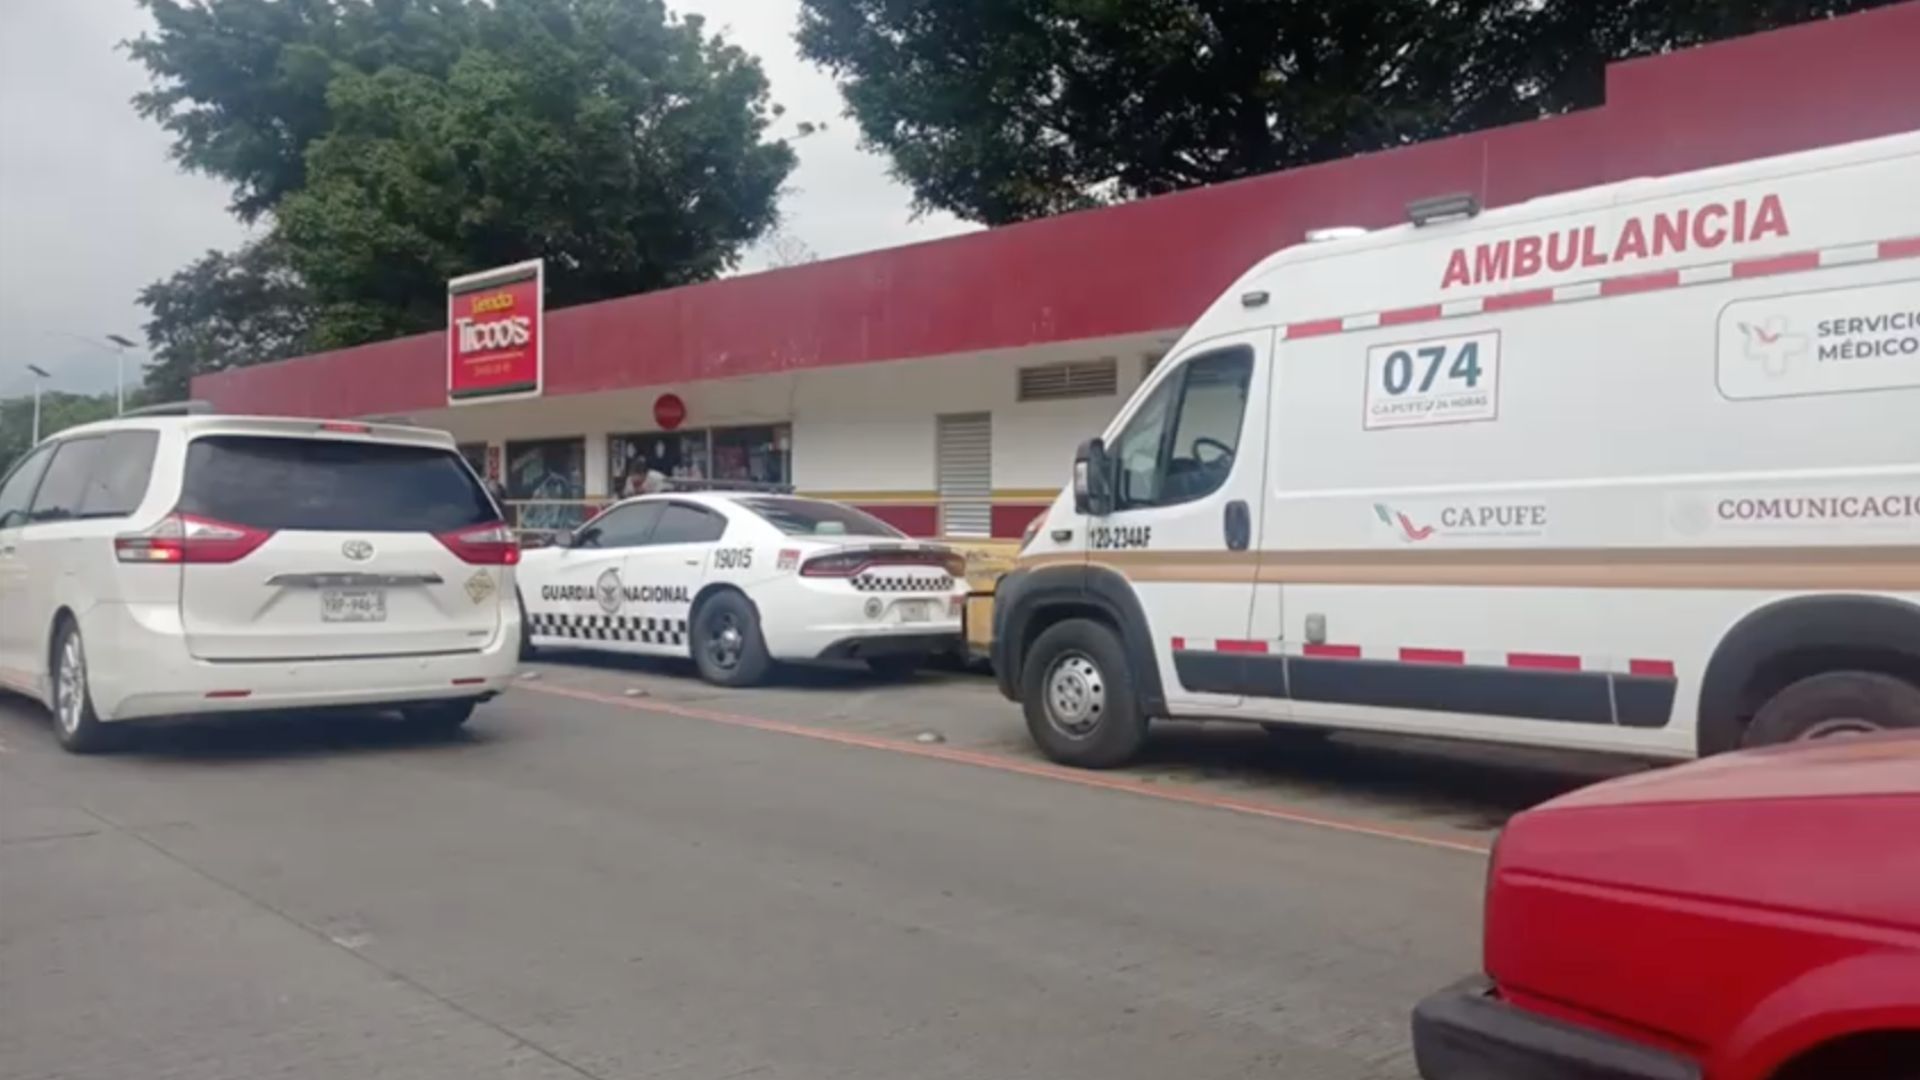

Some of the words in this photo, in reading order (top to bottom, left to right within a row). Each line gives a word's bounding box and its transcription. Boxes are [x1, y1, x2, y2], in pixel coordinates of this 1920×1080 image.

[1440, 194, 1789, 289] AMBULANCIA
[1817, 311, 1920, 338] SERVICI
[1818, 337, 1919, 362] MÉDICO
[1383, 341, 1483, 396] 074
[1441, 504, 1547, 528] CAPUFE
[1090, 526, 1151, 548] 120-234AF
[714, 547, 753, 569] 19015
[541, 584, 596, 601] GUARDIA
[622, 585, 690, 603] NACIONAL
